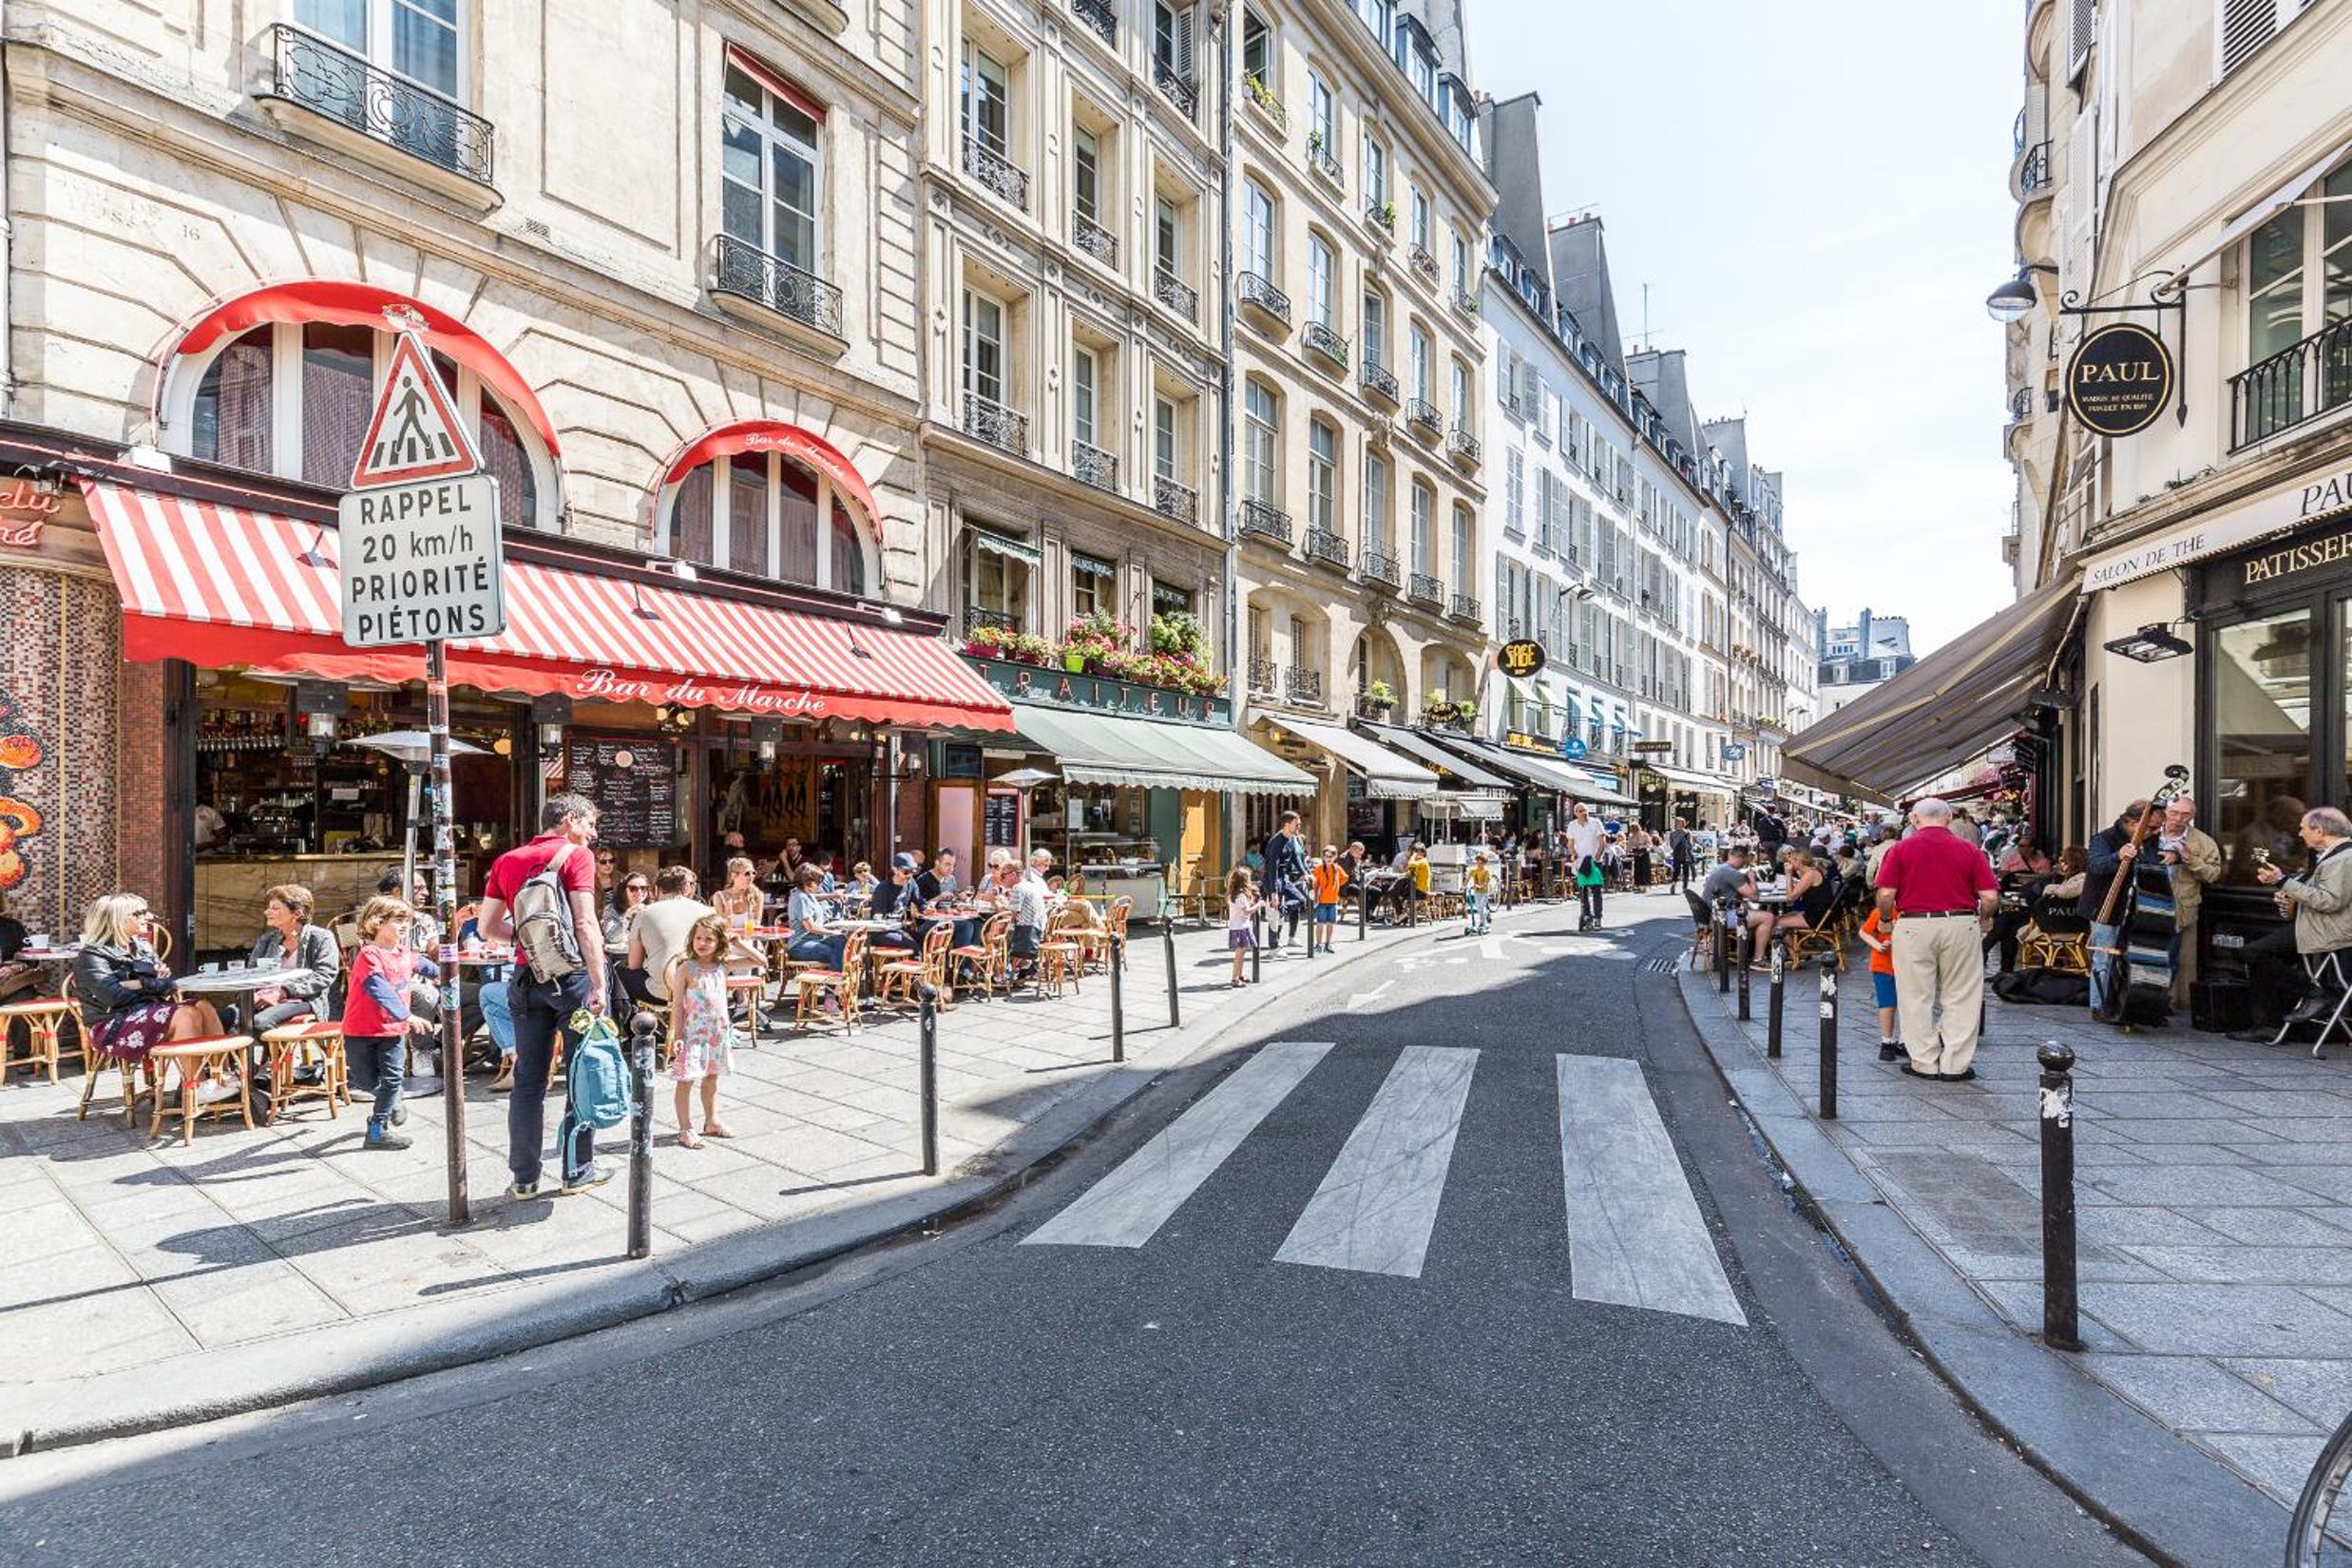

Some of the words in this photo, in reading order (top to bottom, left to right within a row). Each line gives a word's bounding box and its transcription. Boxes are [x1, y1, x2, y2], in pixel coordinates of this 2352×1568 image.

[2079, 361, 2160, 383] PAUL
[744, 433, 773, 446] Bar
[777, 435, 795, 448] du
[360, 484, 472, 526] RAPPEL
[362, 533, 396, 564] 20
[410, 525, 473, 559] km/h
[2093, 557, 2139, 584] SALON
[2146, 547, 2167, 567] DE
[2172, 533, 2206, 558] THE
[352, 555, 489, 603] PRIORITÉ
[358, 603, 486, 641] PIÉTONS
[576, 668, 651, 698] Bar
[665, 678, 706, 701] du
[718, 684, 826, 713] Marché
[979, 663, 1215, 723] TRAITEUR
[2048, 907, 2076, 917] PAU
